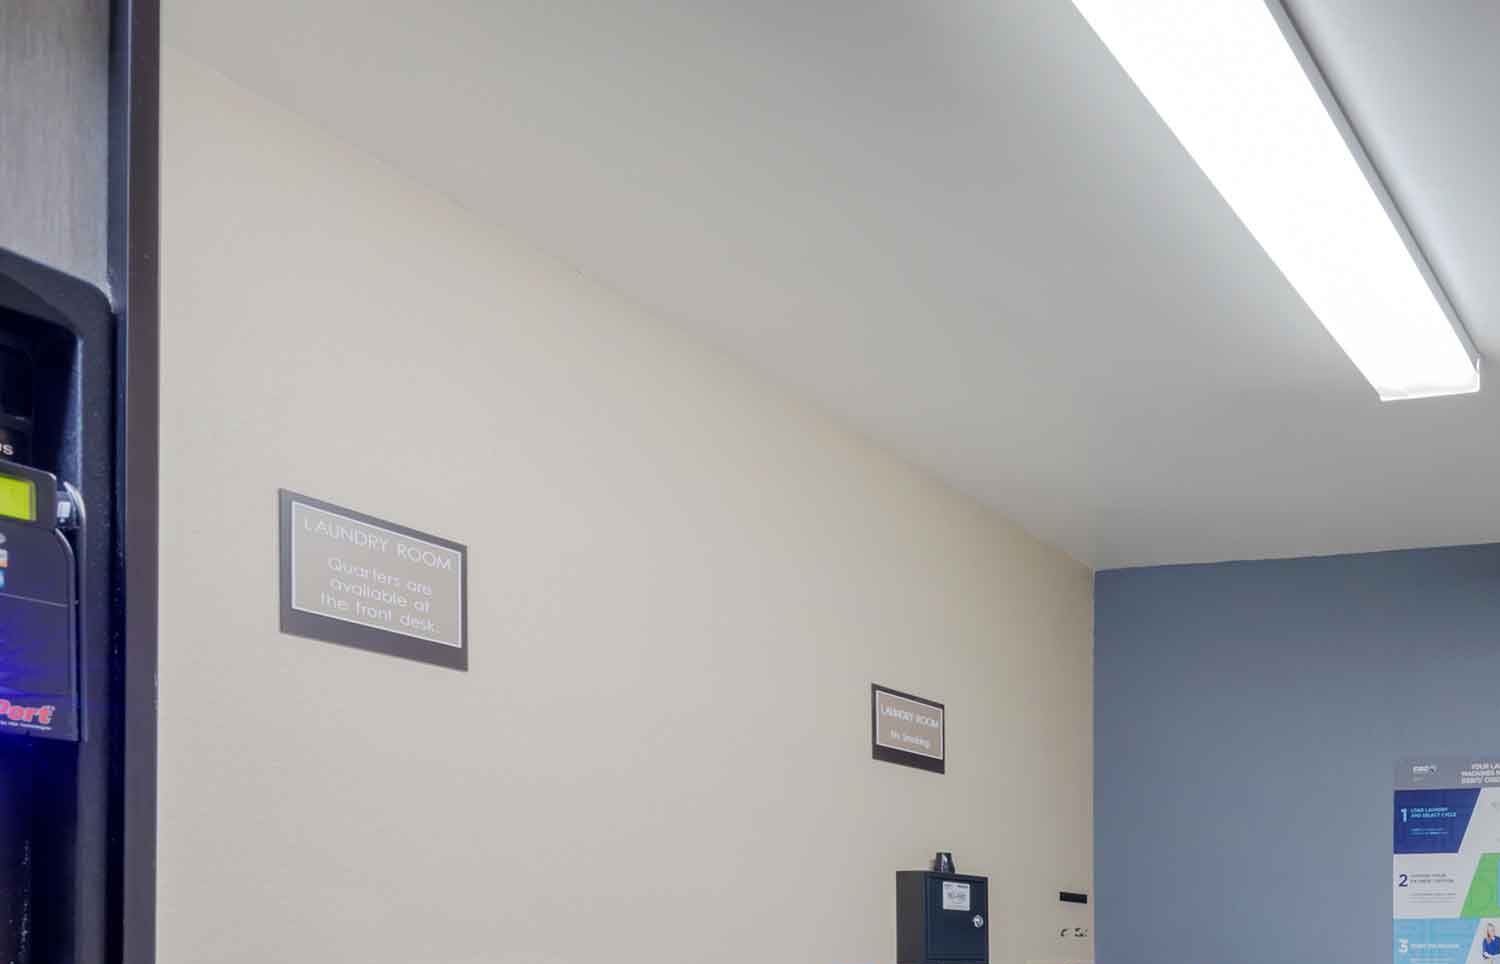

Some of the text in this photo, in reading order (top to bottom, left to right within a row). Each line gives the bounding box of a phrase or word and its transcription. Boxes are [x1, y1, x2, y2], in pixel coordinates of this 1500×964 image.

[304, 517, 451, 569] LAUNDRY ROOM
[328, 557, 432, 596] Quarters are
[320, 592, 348, 609] the
[356, 601, 392, 622] front
[330, 579, 430, 612] available at
[1401, 808, 1408, 822] 1
[1398, 874, 1408, 888] 2
